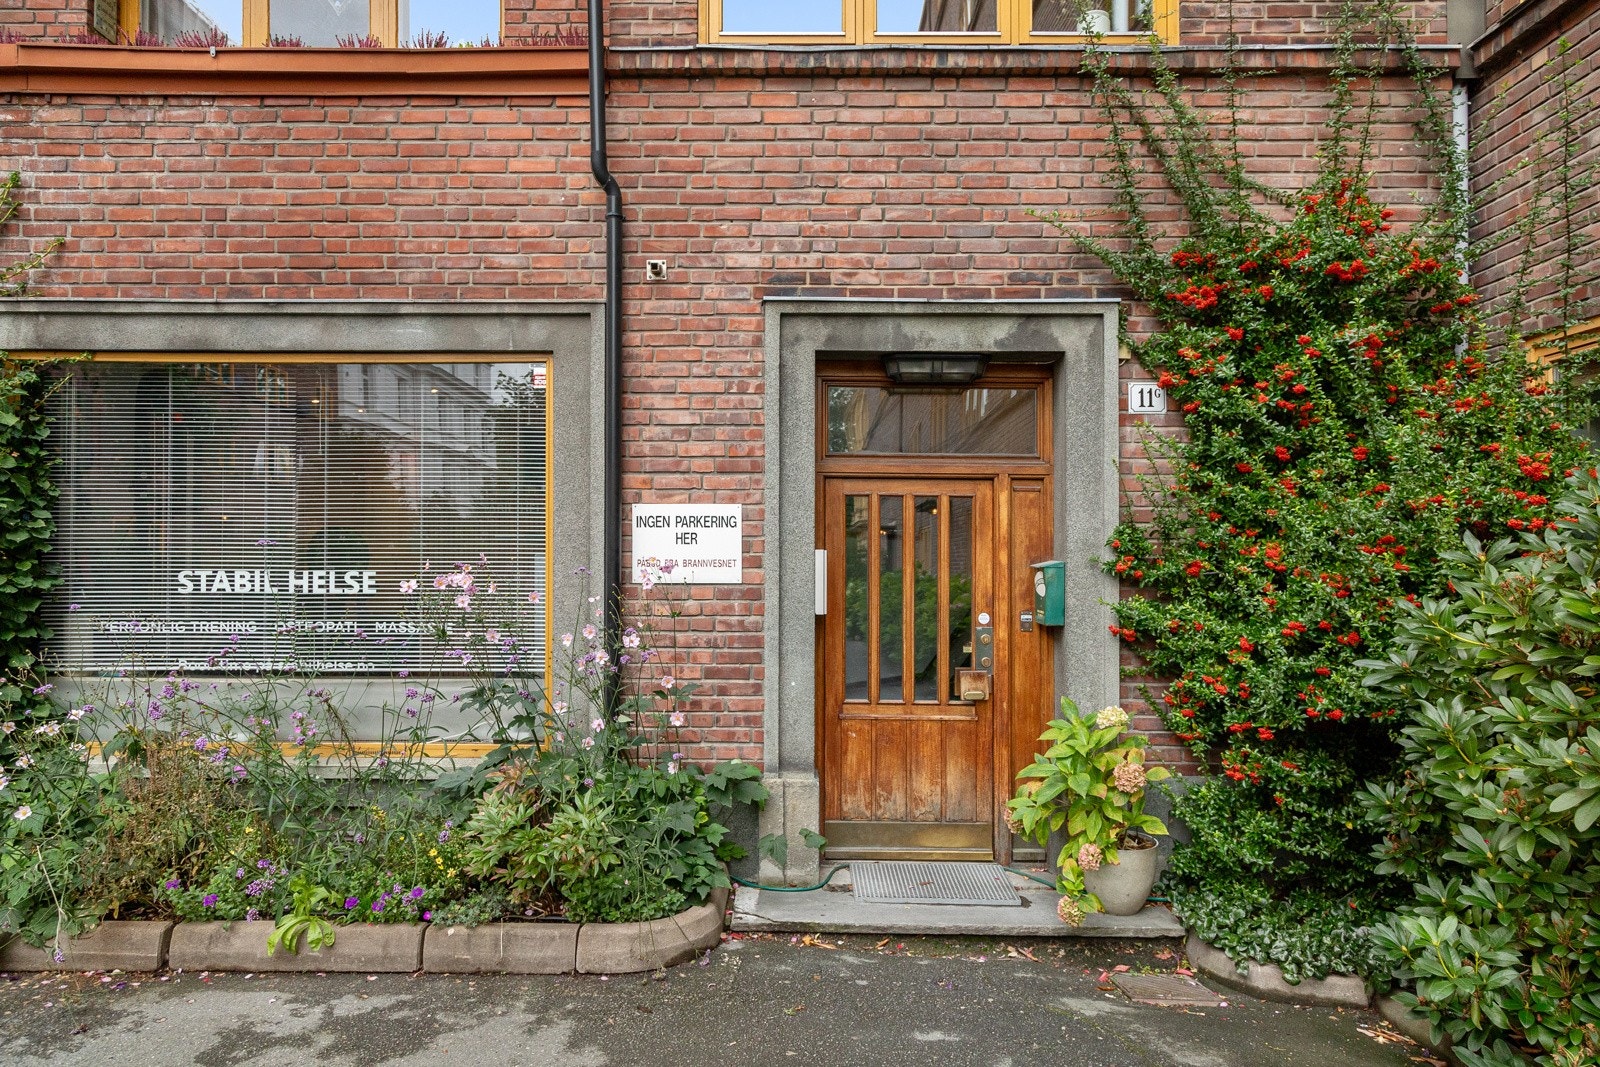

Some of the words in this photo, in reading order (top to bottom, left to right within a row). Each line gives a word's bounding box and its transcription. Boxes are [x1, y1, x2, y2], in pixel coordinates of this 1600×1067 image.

[636, 515, 671, 528] INGEN
[675, 515, 737, 528] PARKERING
[675, 532, 698, 545] HER
[682, 559, 737, 568] BRANNVESNET
[177, 570, 279, 594] STABIL
[288, 570, 377, 594] HELSE
[191, 621, 257, 633] TRENING
[375, 621, 454, 633] MASSASE
